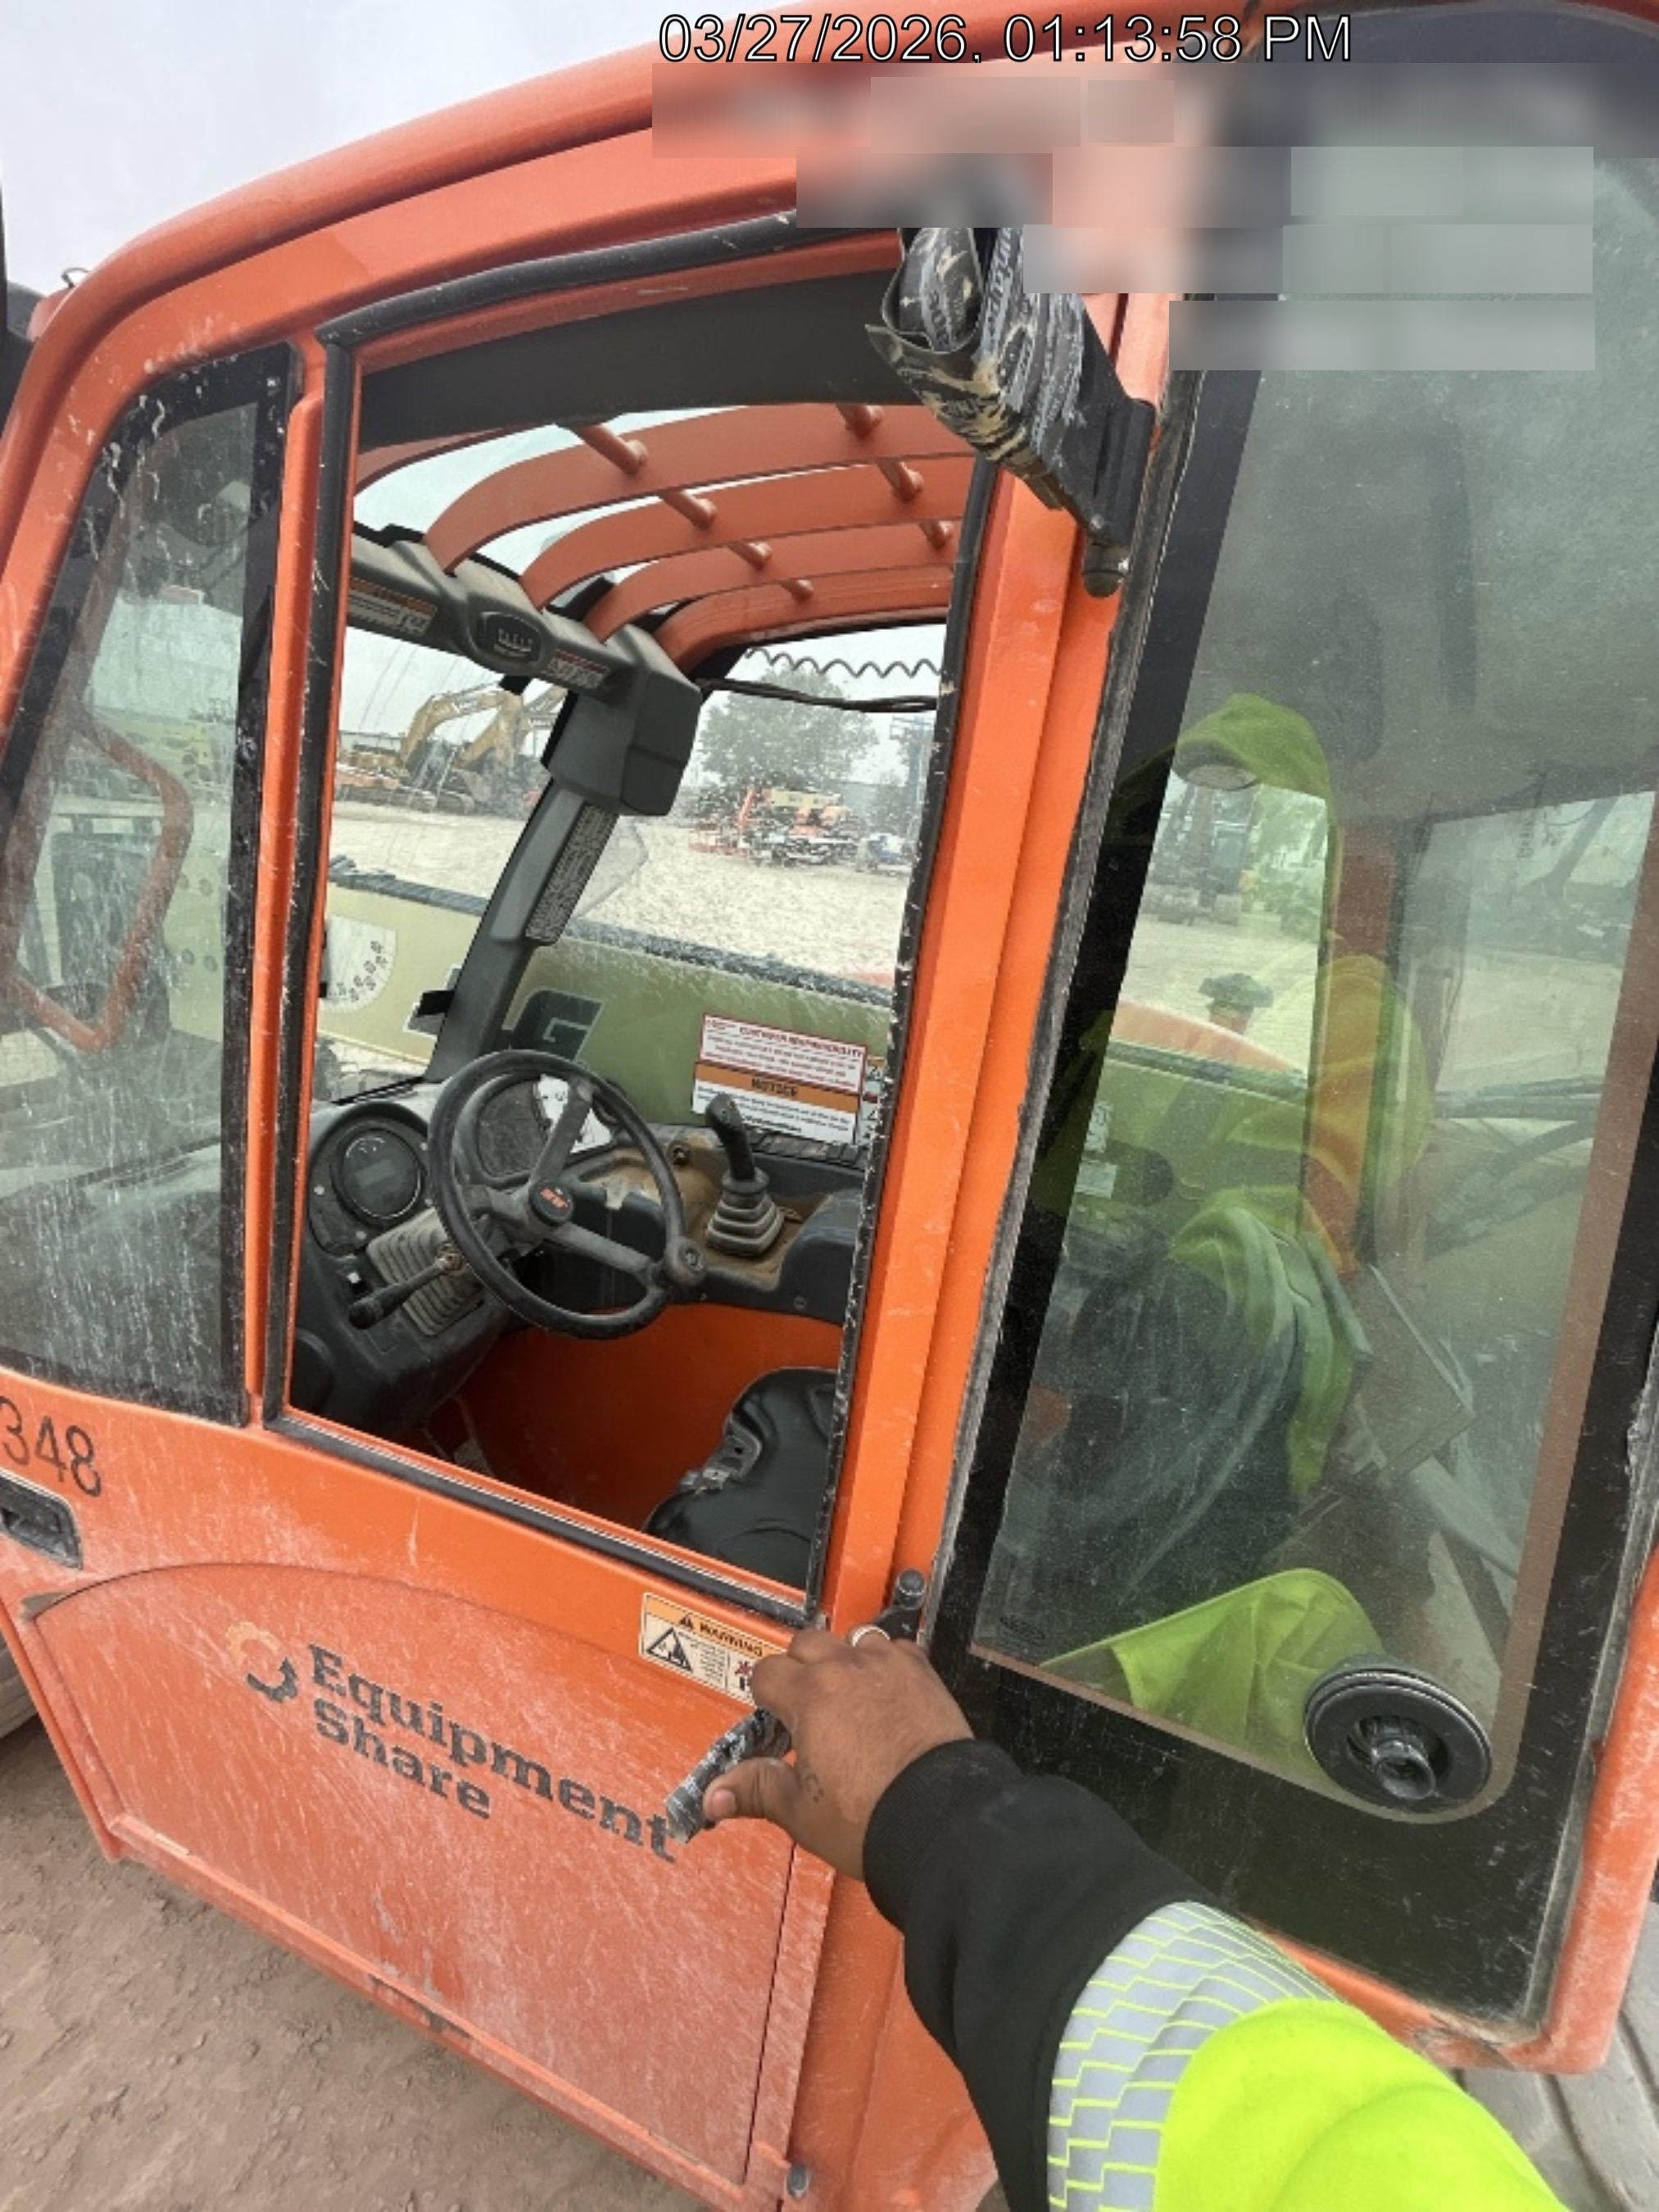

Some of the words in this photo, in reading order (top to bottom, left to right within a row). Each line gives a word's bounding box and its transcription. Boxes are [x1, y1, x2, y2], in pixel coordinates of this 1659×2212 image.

[750, 1078, 799, 1097] NOTICE
[0, 1395, 102, 1497] 348
[699, 1622, 763, 1657] WARNING
[307, 1643, 676, 1864] Equipment
[313, 1696, 491, 1820] Share
